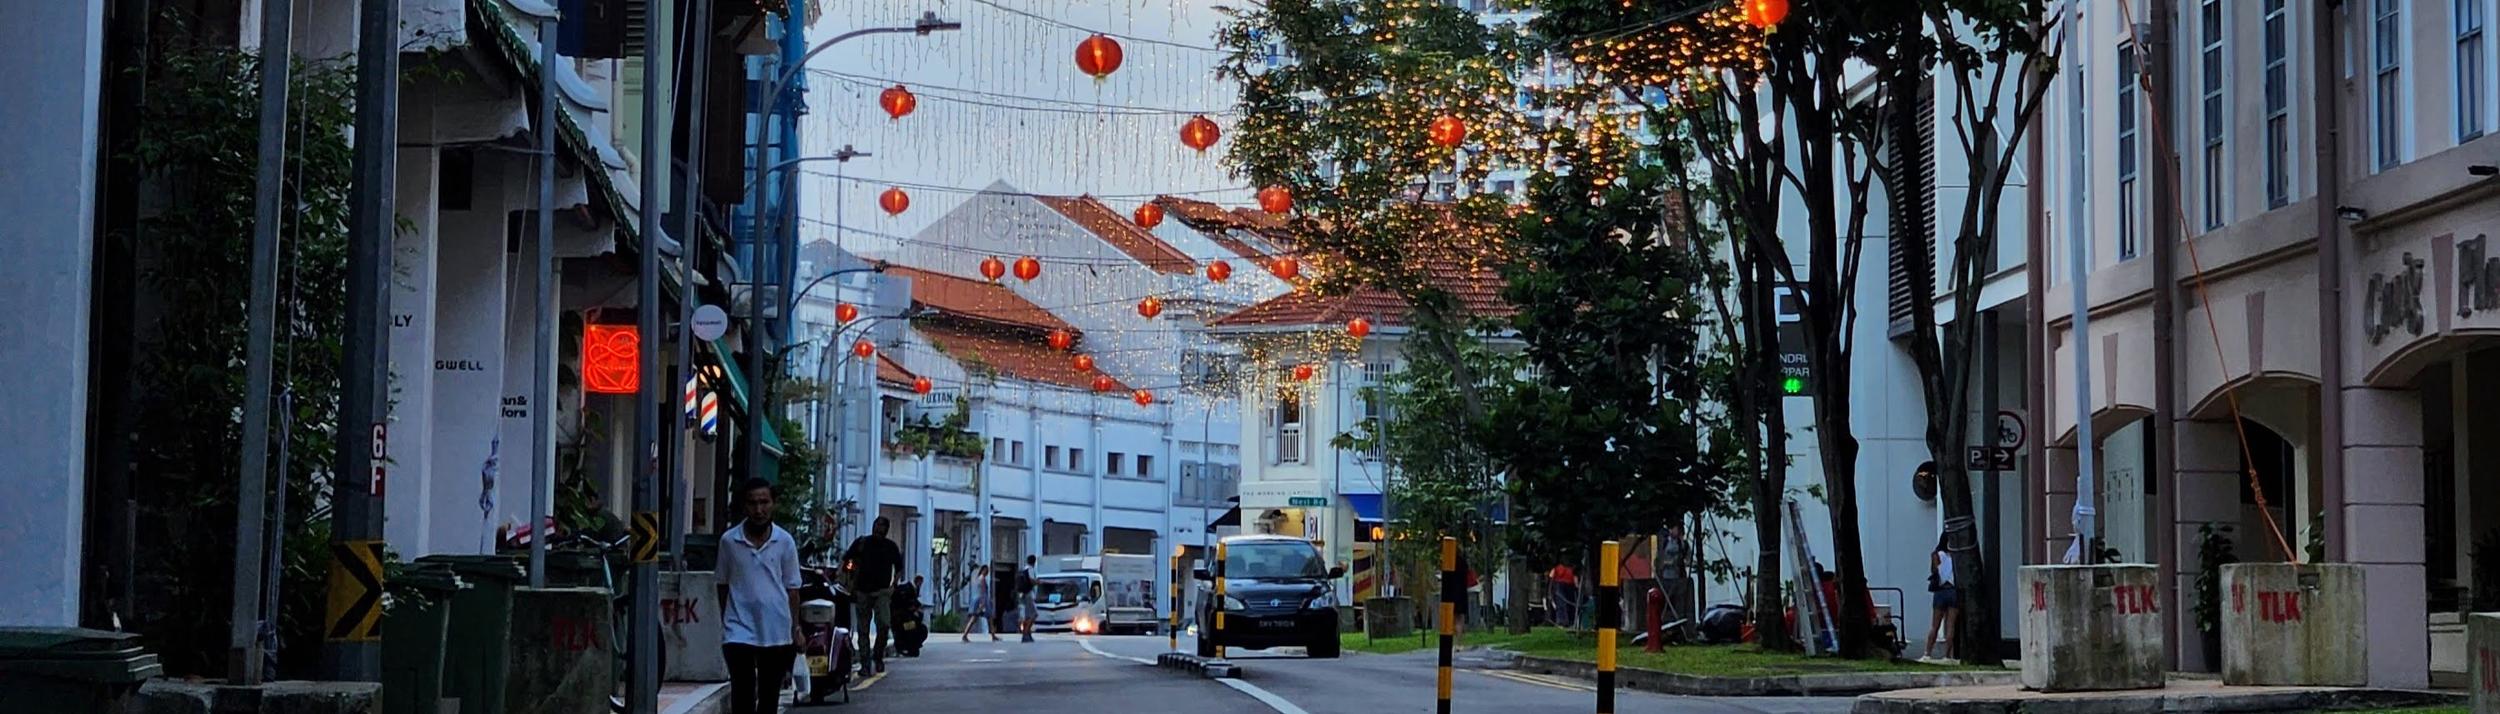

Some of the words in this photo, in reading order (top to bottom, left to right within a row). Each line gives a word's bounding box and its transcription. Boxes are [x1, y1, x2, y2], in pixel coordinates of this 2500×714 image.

[390, 314, 413, 327] LY
[660, 597, 699, 624] TLK
[2113, 584, 2158, 614] TLK
[2258, 591, 2301, 624] TLK
